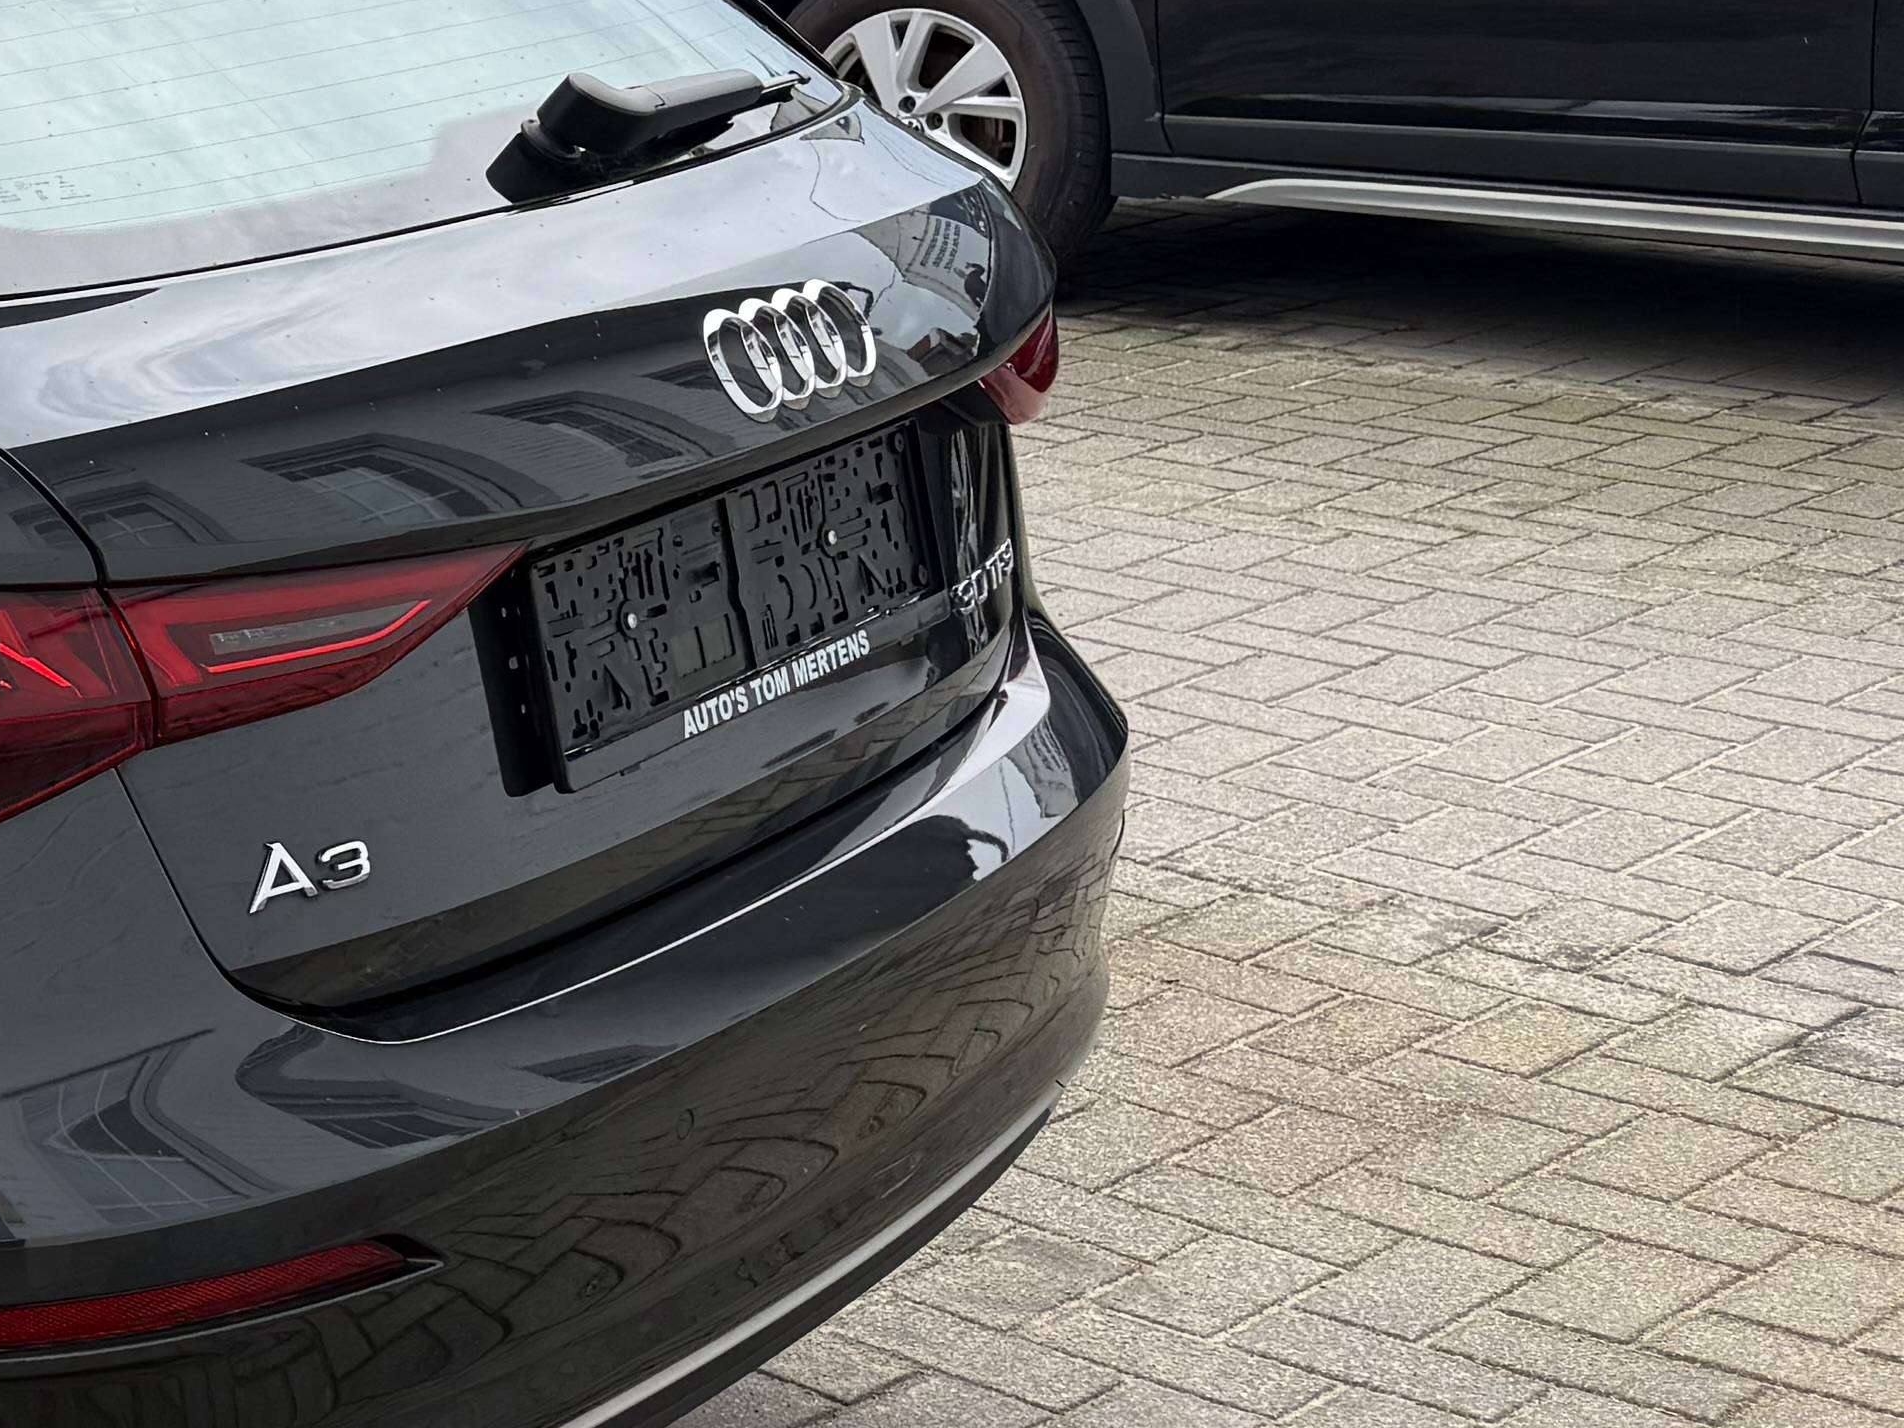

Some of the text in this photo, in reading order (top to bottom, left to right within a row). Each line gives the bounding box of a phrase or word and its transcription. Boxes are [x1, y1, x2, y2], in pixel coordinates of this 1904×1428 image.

[682, 629, 871, 739] AUTO'S TOM MERTENS
[249, 840, 372, 914] A3
